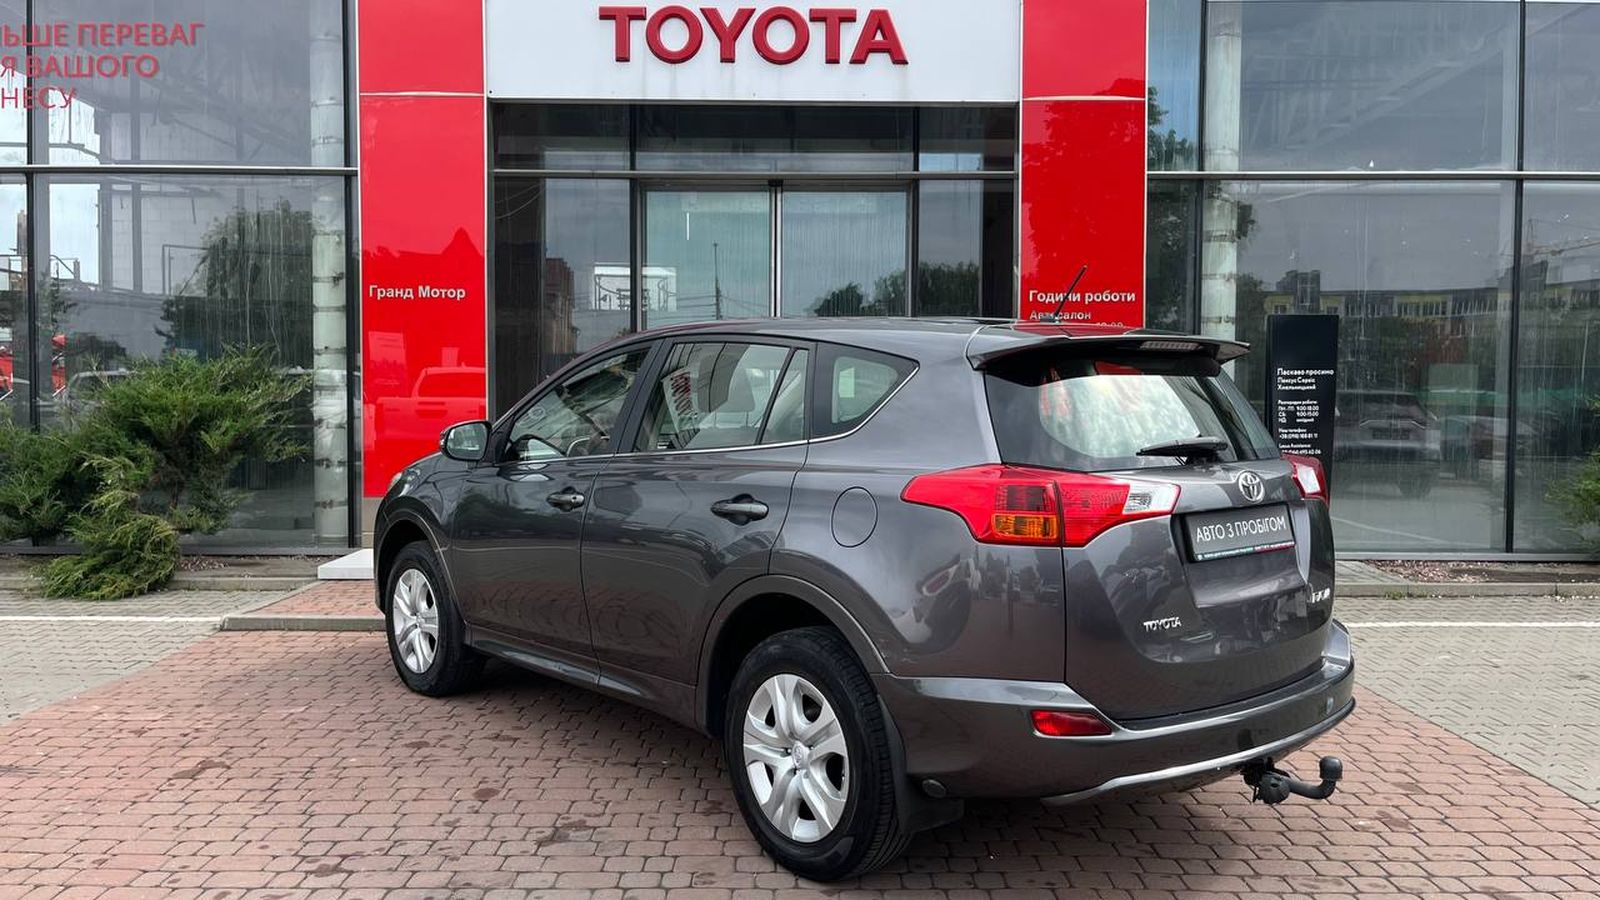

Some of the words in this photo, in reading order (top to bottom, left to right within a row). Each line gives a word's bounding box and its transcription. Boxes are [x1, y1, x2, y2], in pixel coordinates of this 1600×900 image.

[0, 22, 67, 47] ЬШЕ
[77, 22, 205, 47] ПЕРЕВАГ
[598, 5, 909, 65] TOYOTA
[26, 54, 160, 78] ВАШОГО
[1, 86, 76, 109] НЕСУ
[369, 285, 414, 301] Гранд
[418, 285, 466, 300] Мотор
[1029, 289, 1080, 304] Години
[1085, 289, 1136, 304] роботи
[1196, 524, 1225, 542] АВТО
[1234, 515, 1287, 537] ПРОБІГОМ
[1143, 616, 1182, 632] TOYOTA
